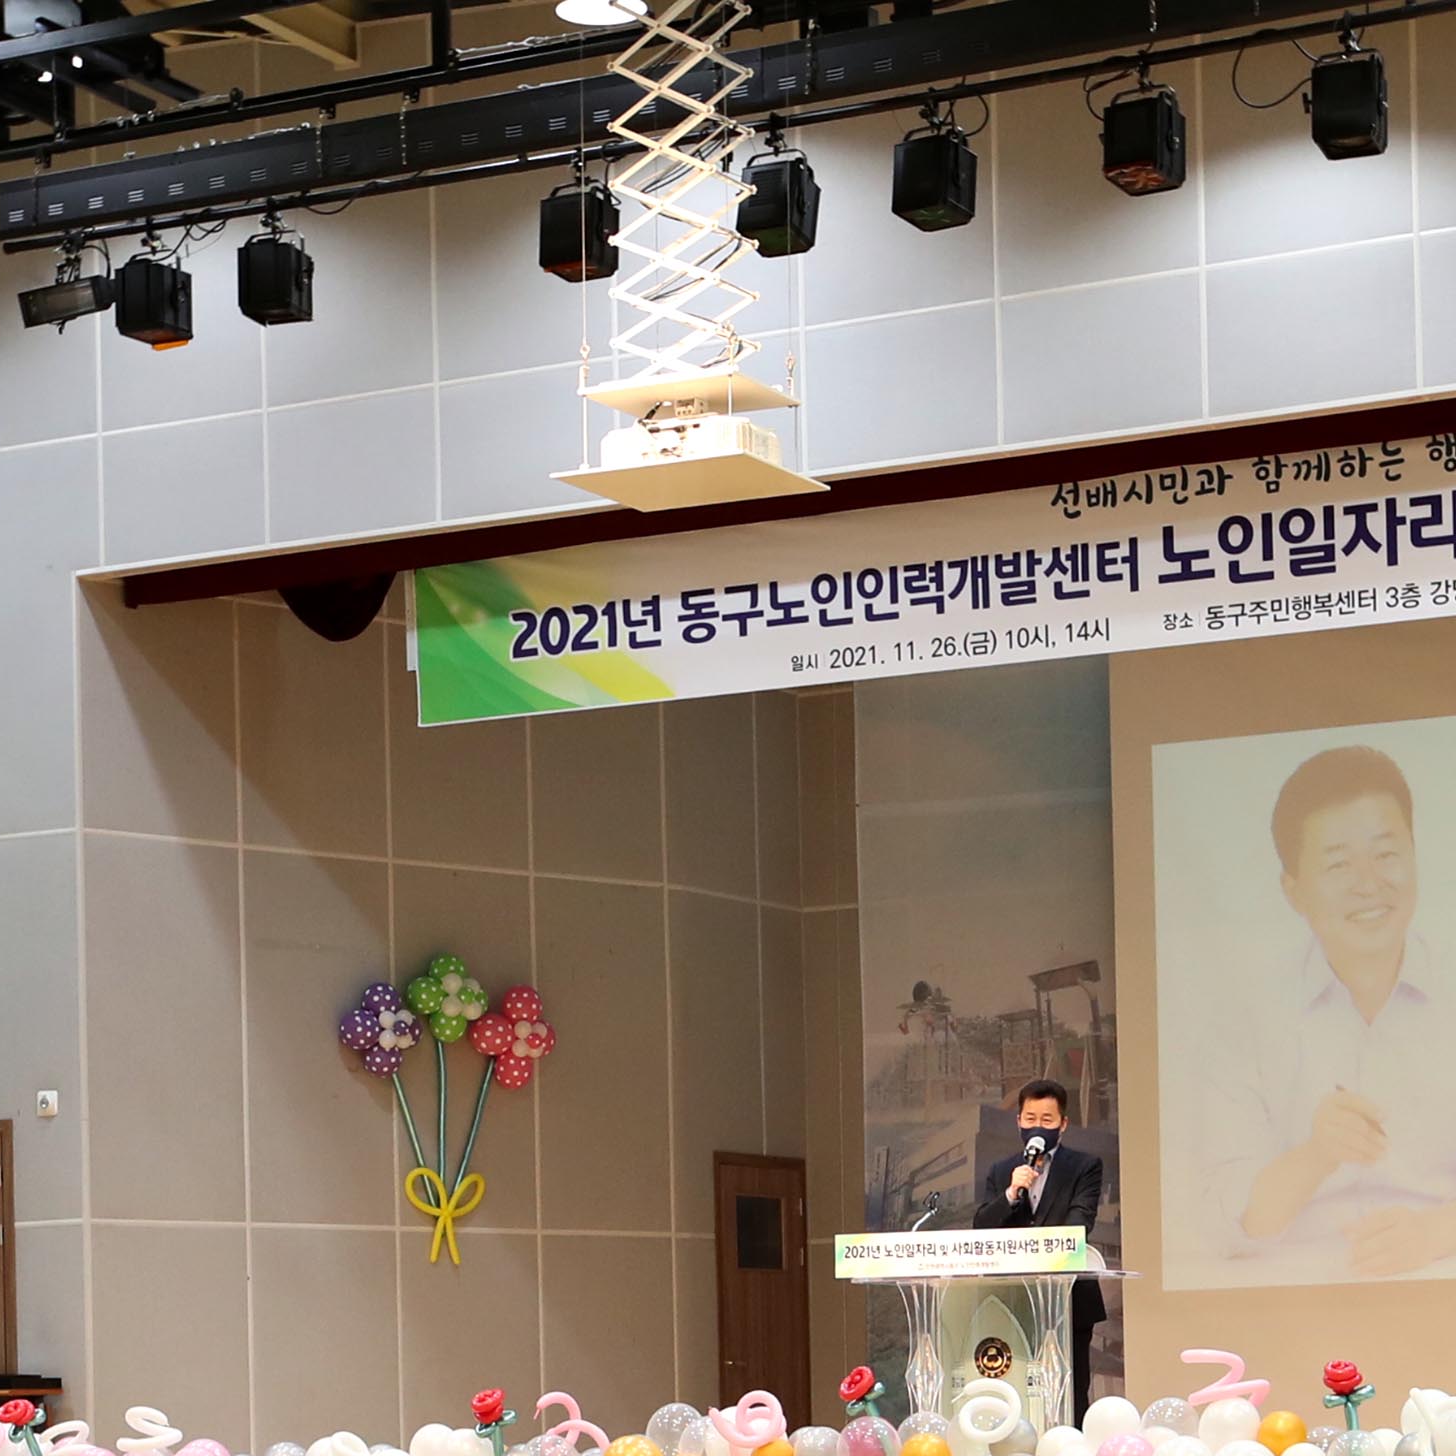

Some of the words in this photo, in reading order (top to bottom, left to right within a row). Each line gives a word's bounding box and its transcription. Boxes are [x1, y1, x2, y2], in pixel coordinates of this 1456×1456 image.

[1050, 464, 1234, 520] 선배시민과
[1250, 440, 1406, 494] 함께하는
[511, 594, 662, 659] 2021년
[677, 536, 1140, 644] 동구노인인력개발센터
[1162, 613, 1194, 631] 장소
[1204, 587, 1378, 631] 동구주민행복센터
[1384, 582, 1423, 610] 3층
[790, 653, 819, 673] 일시
[828, 645, 886, 670] 2021.
[893, 640, 924, 663] 11.
[930, 629, 998, 657] 26.(금)
[1004, 623, 1057, 650] 10시,
[1064, 617, 1111, 642] 14시
[844, 1244, 881, 1259] 2021년
[884, 1243, 937, 1258] 노인일자리
[1043, 1237, 1076, 1253] 평가회
